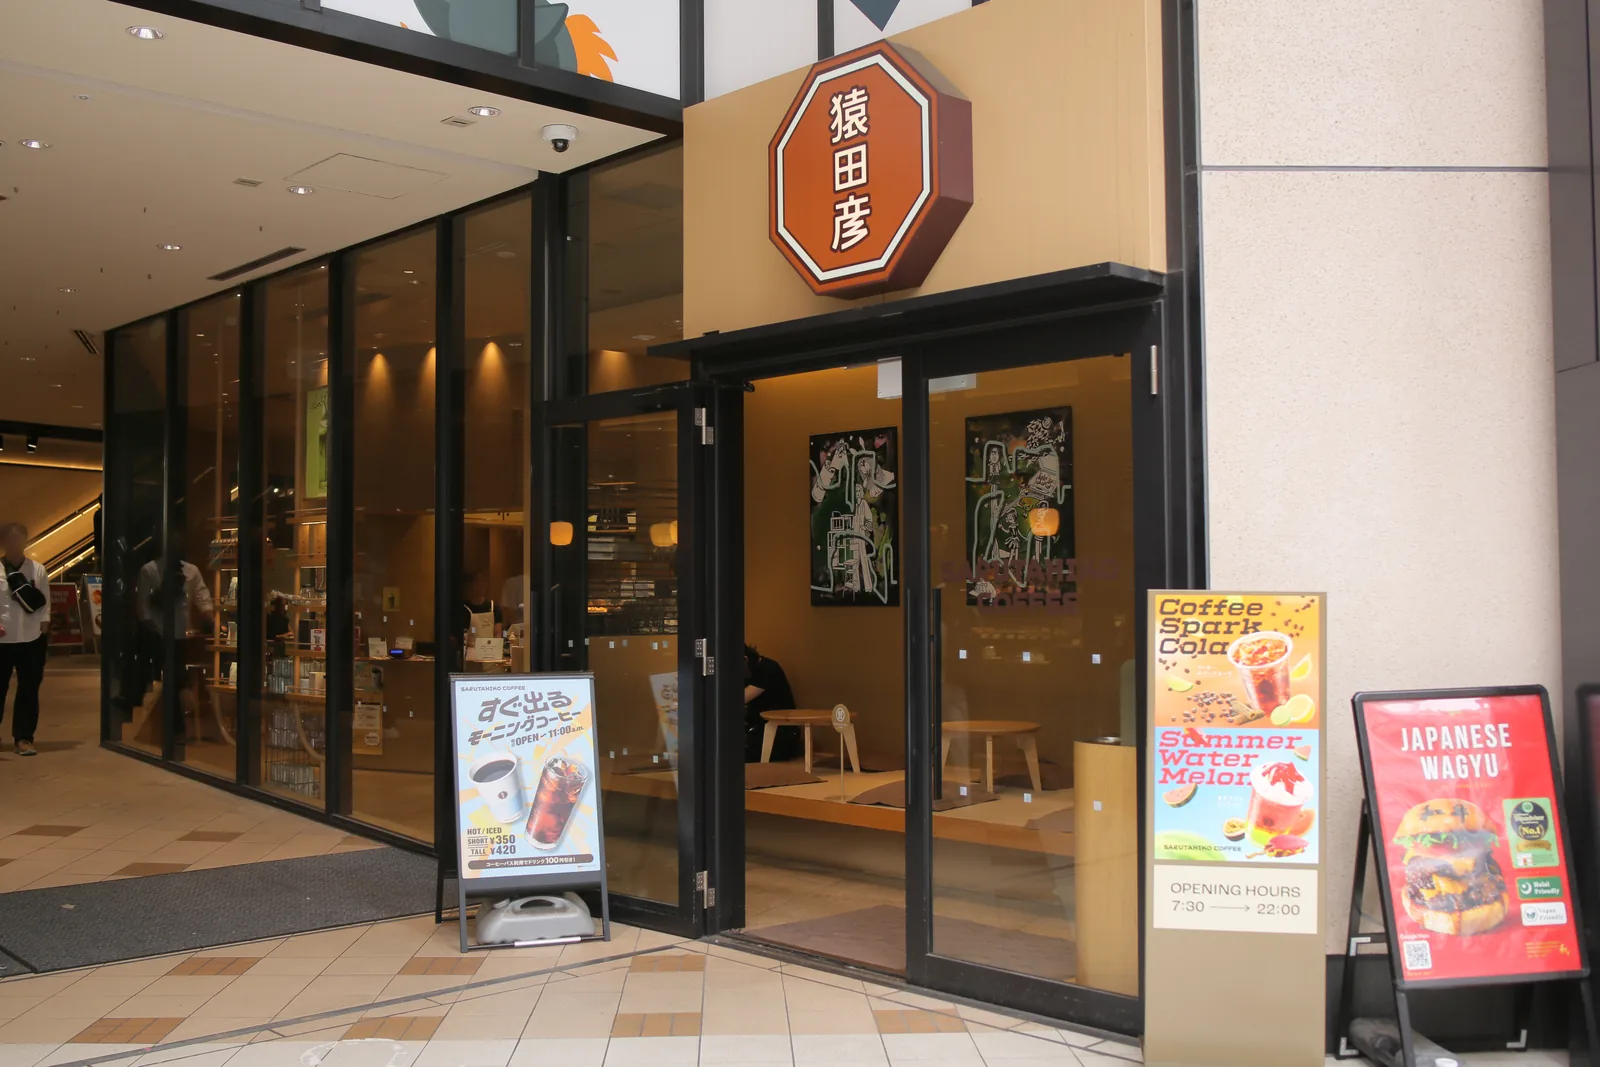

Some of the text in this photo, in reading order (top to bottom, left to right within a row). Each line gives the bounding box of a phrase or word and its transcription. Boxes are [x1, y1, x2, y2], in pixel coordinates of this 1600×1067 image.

[829, 87, 871, 250] 猿田彦
[1159, 598, 1264, 616] Coffee
[1159, 617, 1263, 638] Spark
[1159, 637, 1230, 655] Cola
[477, 691, 573, 723] すぐ出る
[467, 711, 582, 746] モーニングコーヒー
[1400, 723, 1513, 752] JAPANESE
[1158, 730, 1303, 749] Summer
[1158, 749, 1260, 767] Water
[1419, 753, 1499, 780] WAGYU
[489, 834, 516, 845] ¥350
[490, 845, 517, 855] ¥420
[1170, 882, 1301, 898] OPENING HOURS
[1171, 900, 1300, 916] 7:30 22:00
